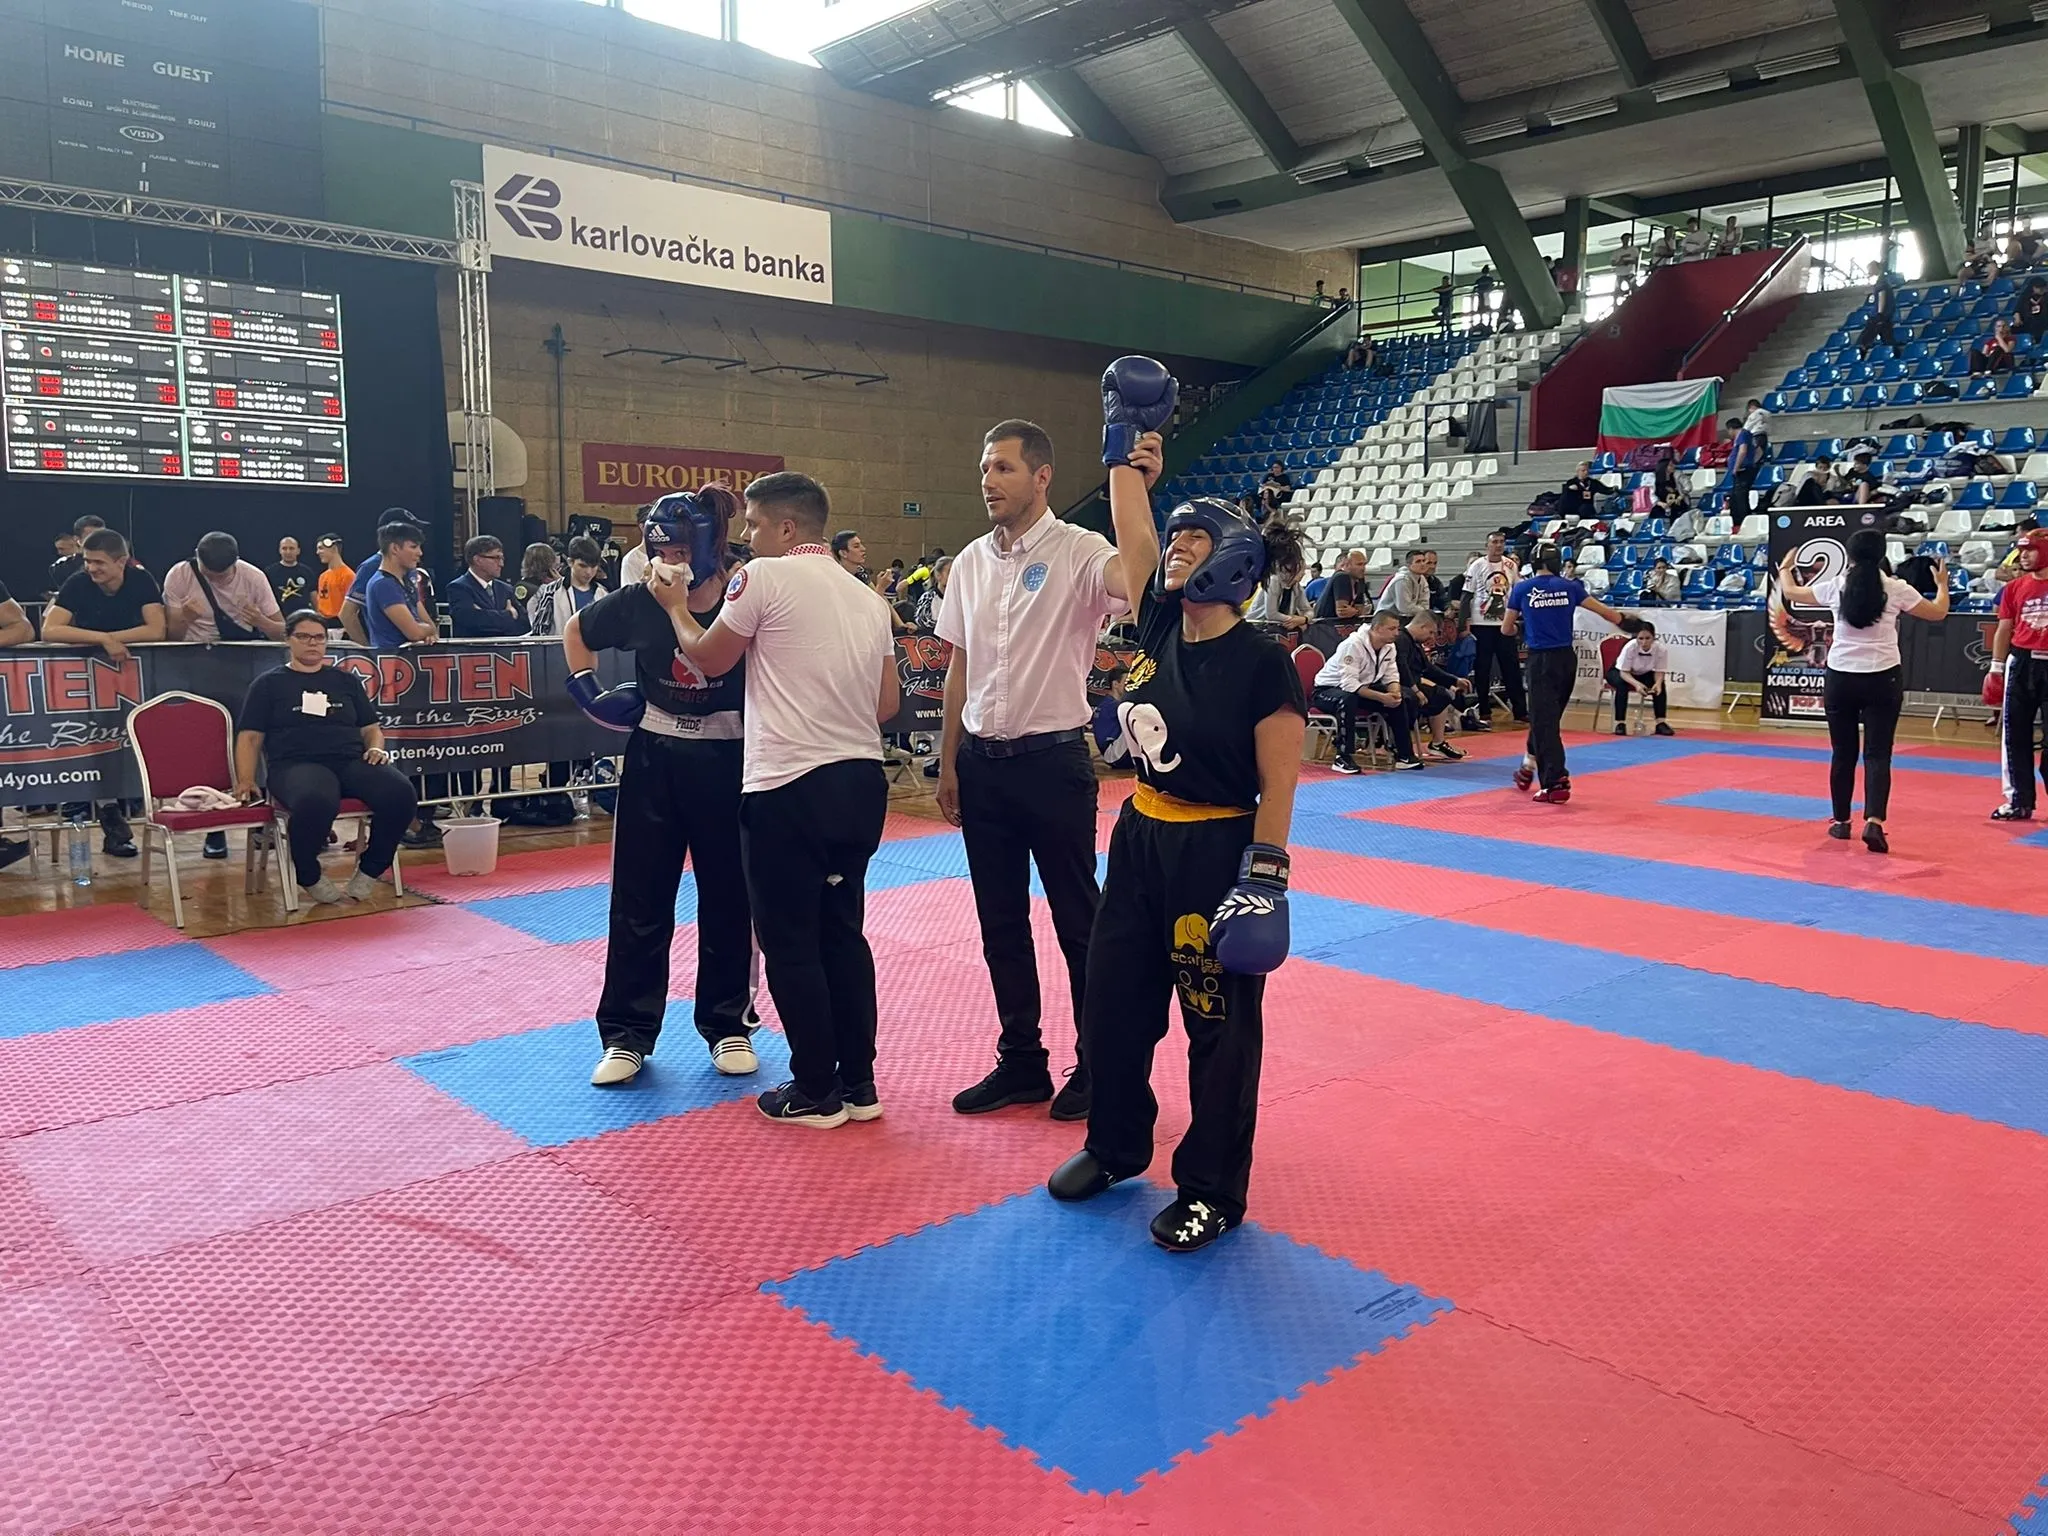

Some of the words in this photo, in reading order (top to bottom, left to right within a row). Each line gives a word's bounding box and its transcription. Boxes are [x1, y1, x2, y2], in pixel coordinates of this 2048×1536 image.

[64, 44, 125, 67] HOME
[152, 61, 213, 83] GUEST
[570, 216, 735, 271] karlovačka
[743, 246, 826, 284] banka
[1804, 515, 1846, 528] AREA
[1791, 537, 1848, 611] 2
[417, 651, 534, 705] TEN
[1771, 667, 1800, 675] WAKO
[0, 656, 146, 717] TEN
[415, 709, 454, 725] the
[0, 723, 33, 746] he
[0, 768, 102, 791] 4you.com
